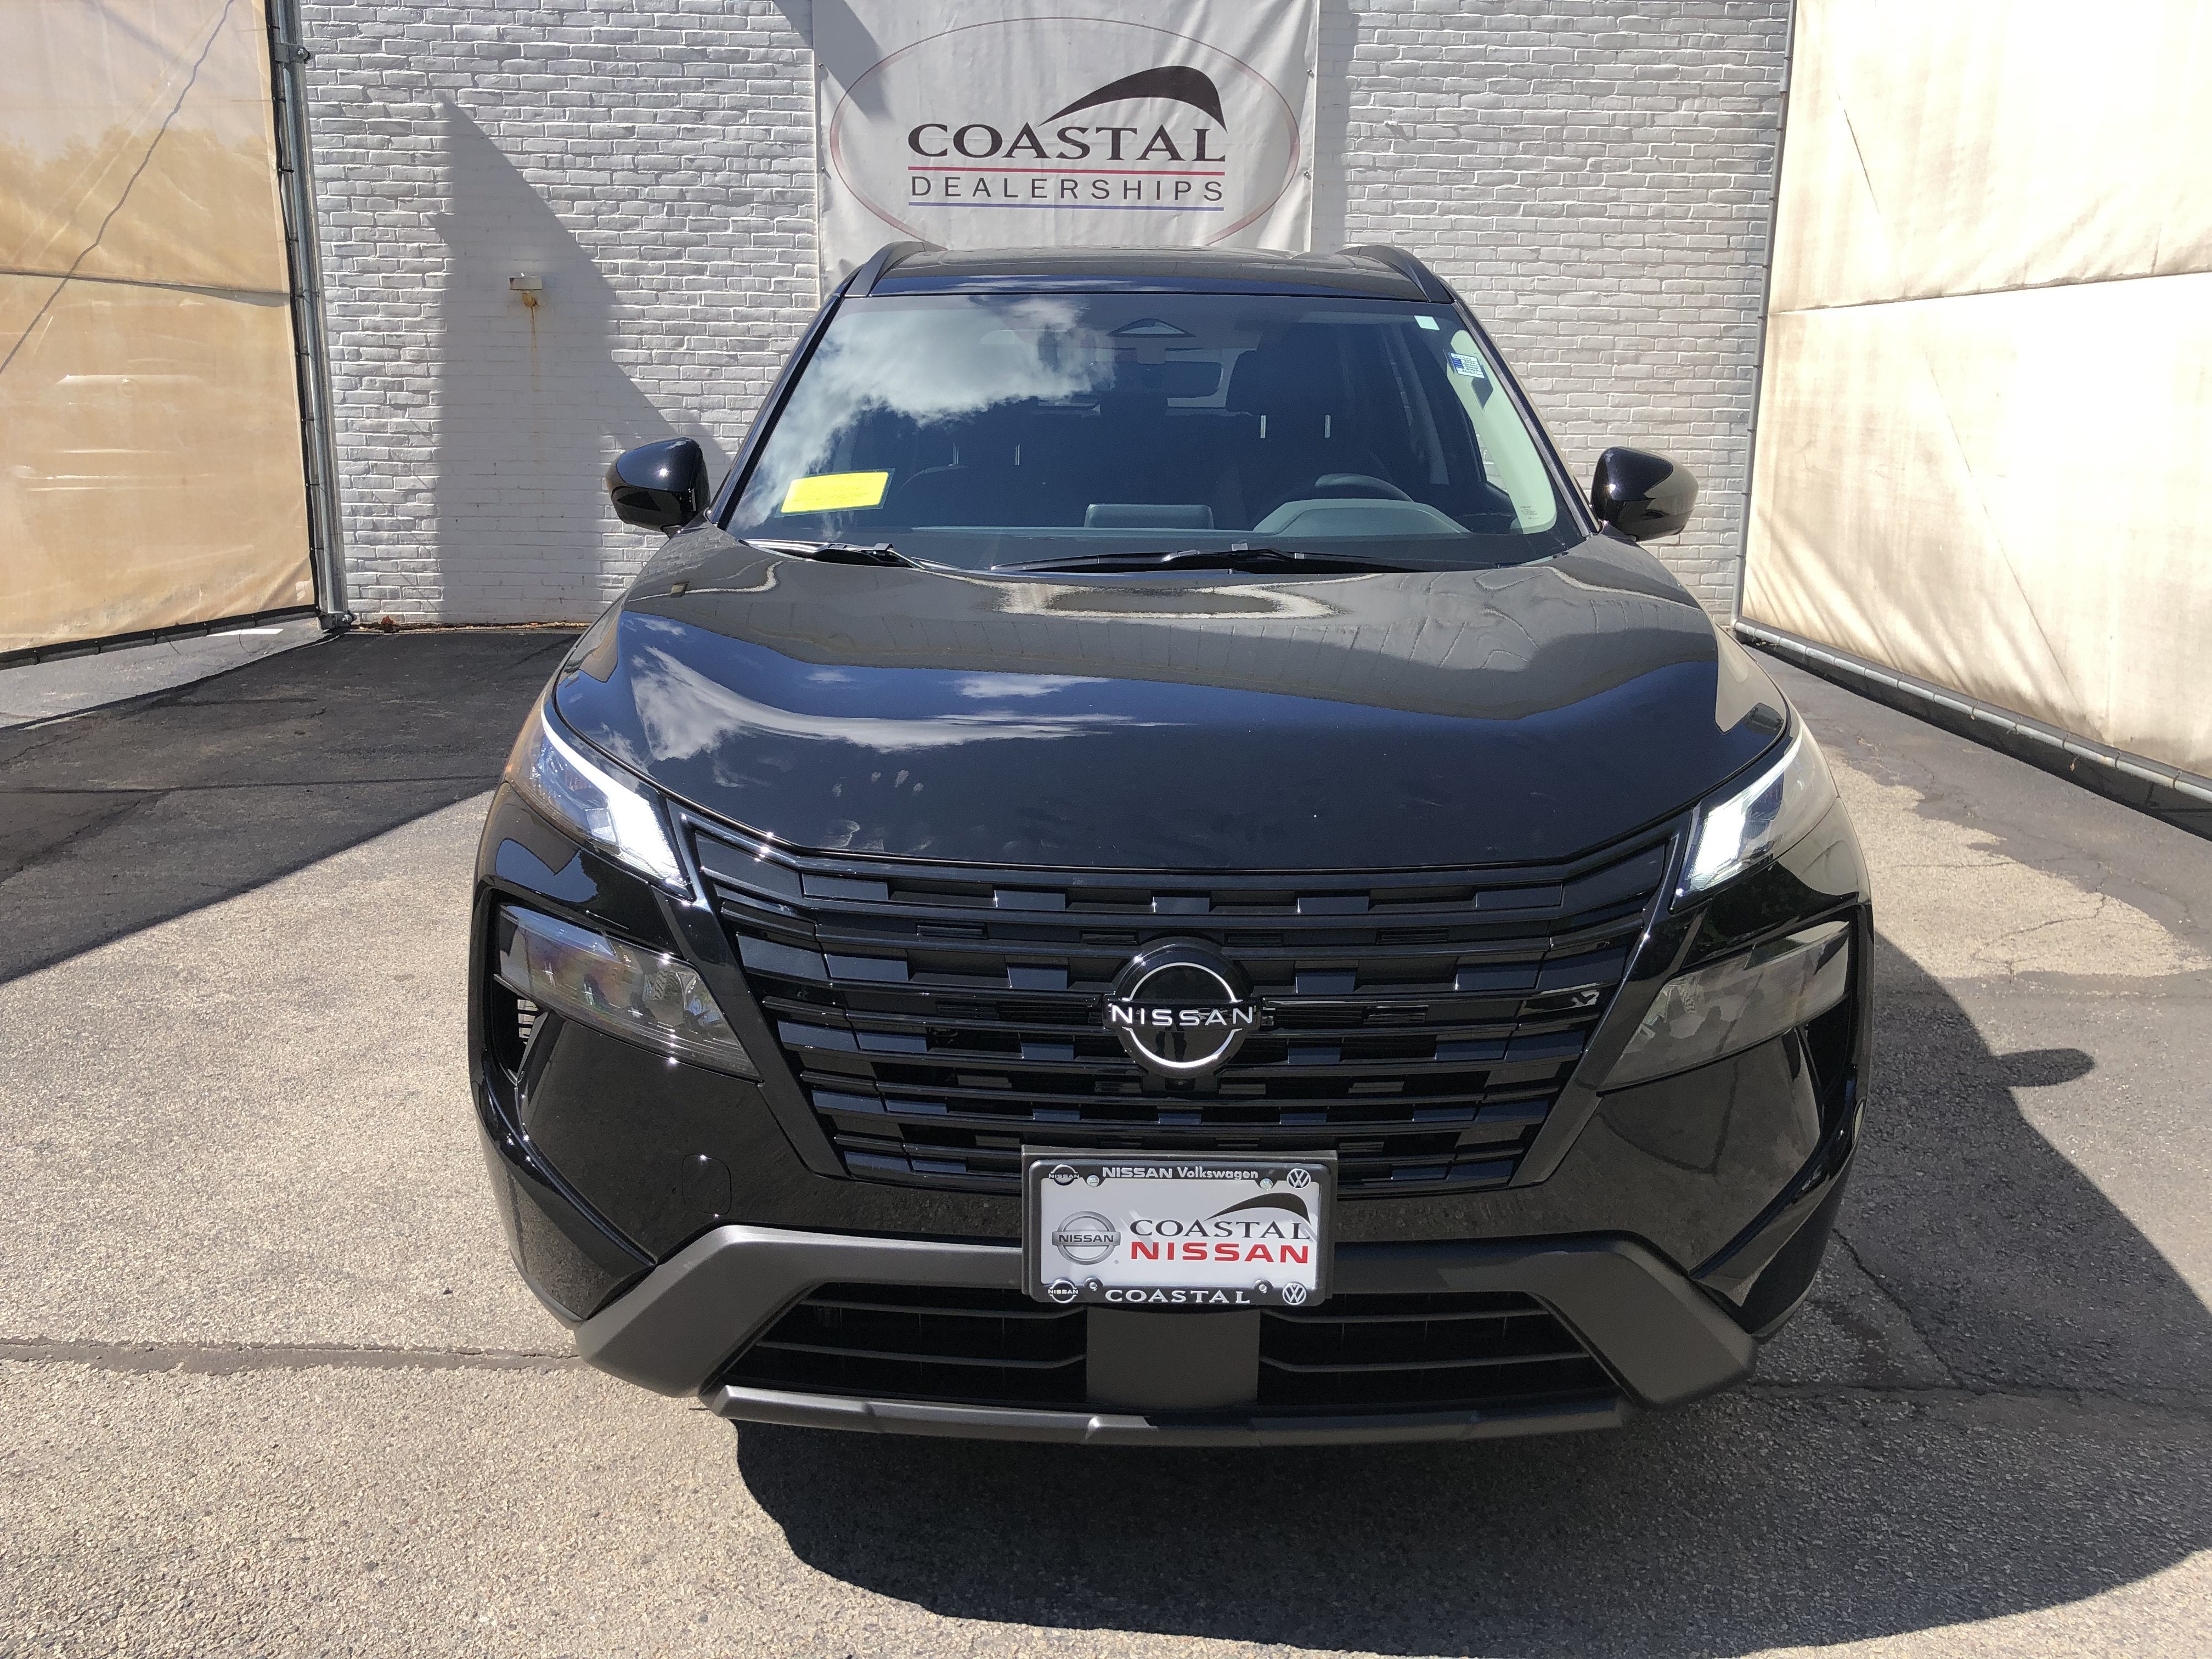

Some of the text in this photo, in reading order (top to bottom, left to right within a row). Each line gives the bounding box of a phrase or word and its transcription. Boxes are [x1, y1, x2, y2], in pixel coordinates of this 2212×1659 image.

[907, 121, 1226, 163] COASTAL
[911, 176, 1223, 201] DEALERSHIPS
[1111, 1005, 1253, 1026] NISSAN
[1102, 1166, 1259, 1180] NISSAN Volkswagen
[1059, 1234, 1114, 1243] NISSAN
[1130, 1219, 1311, 1240] COASTAL
[1130, 1242, 1308, 1264] NISSAN
[1105, 1289, 1250, 1304] COASTAL
